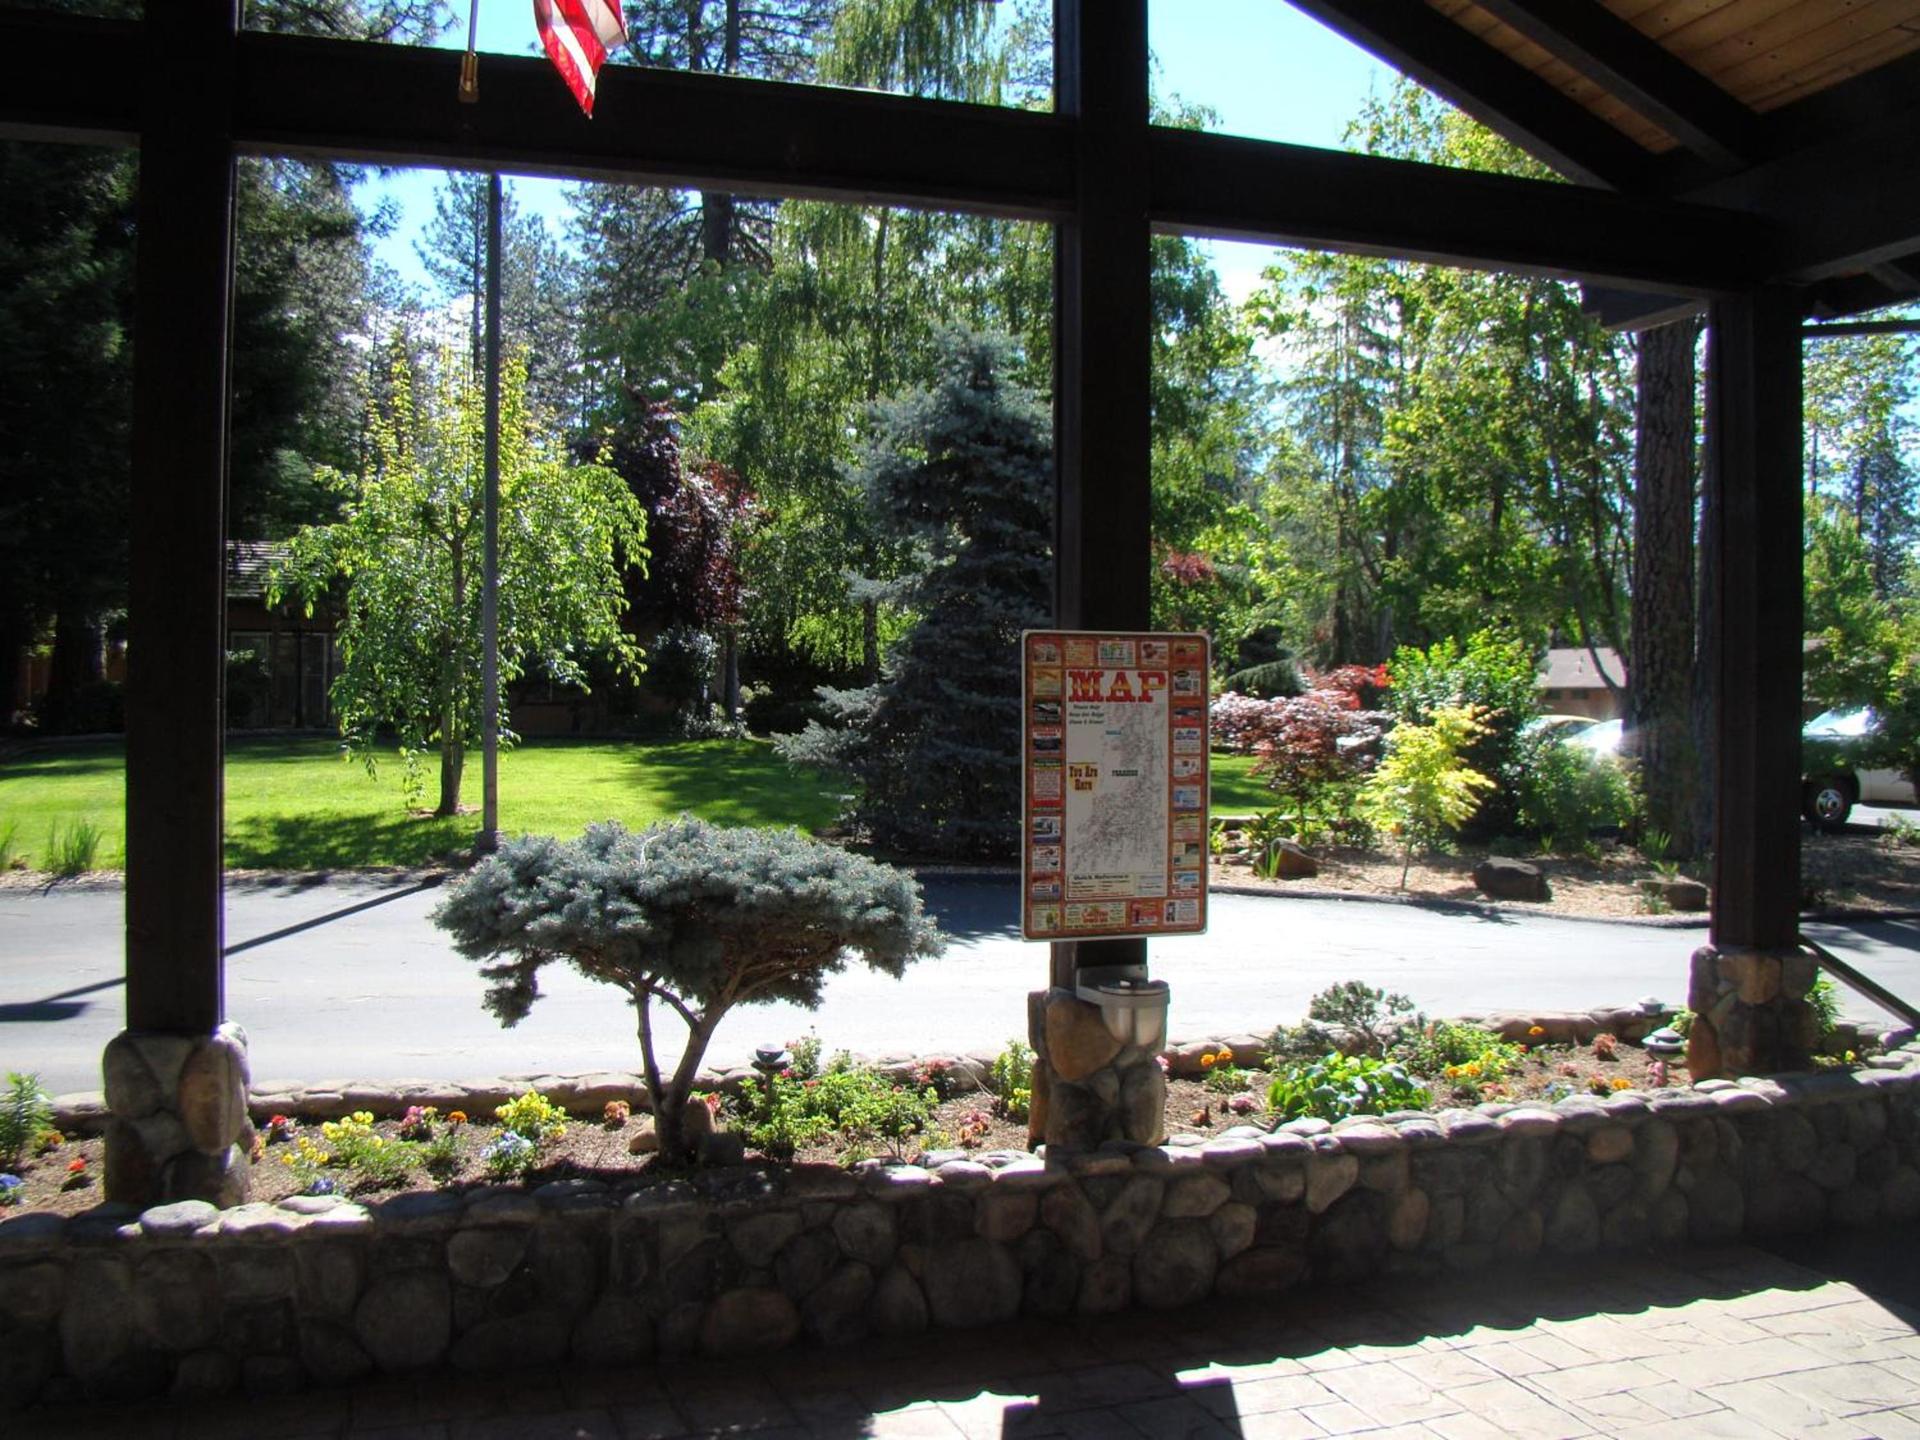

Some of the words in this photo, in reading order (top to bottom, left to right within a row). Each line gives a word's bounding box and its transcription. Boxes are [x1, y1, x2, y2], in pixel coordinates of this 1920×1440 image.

[1068, 670, 1167, 702] MAP
[1069, 766, 1082, 778] You
[1085, 766, 1098, 777] Are
[1075, 779, 1092, 791] Here
